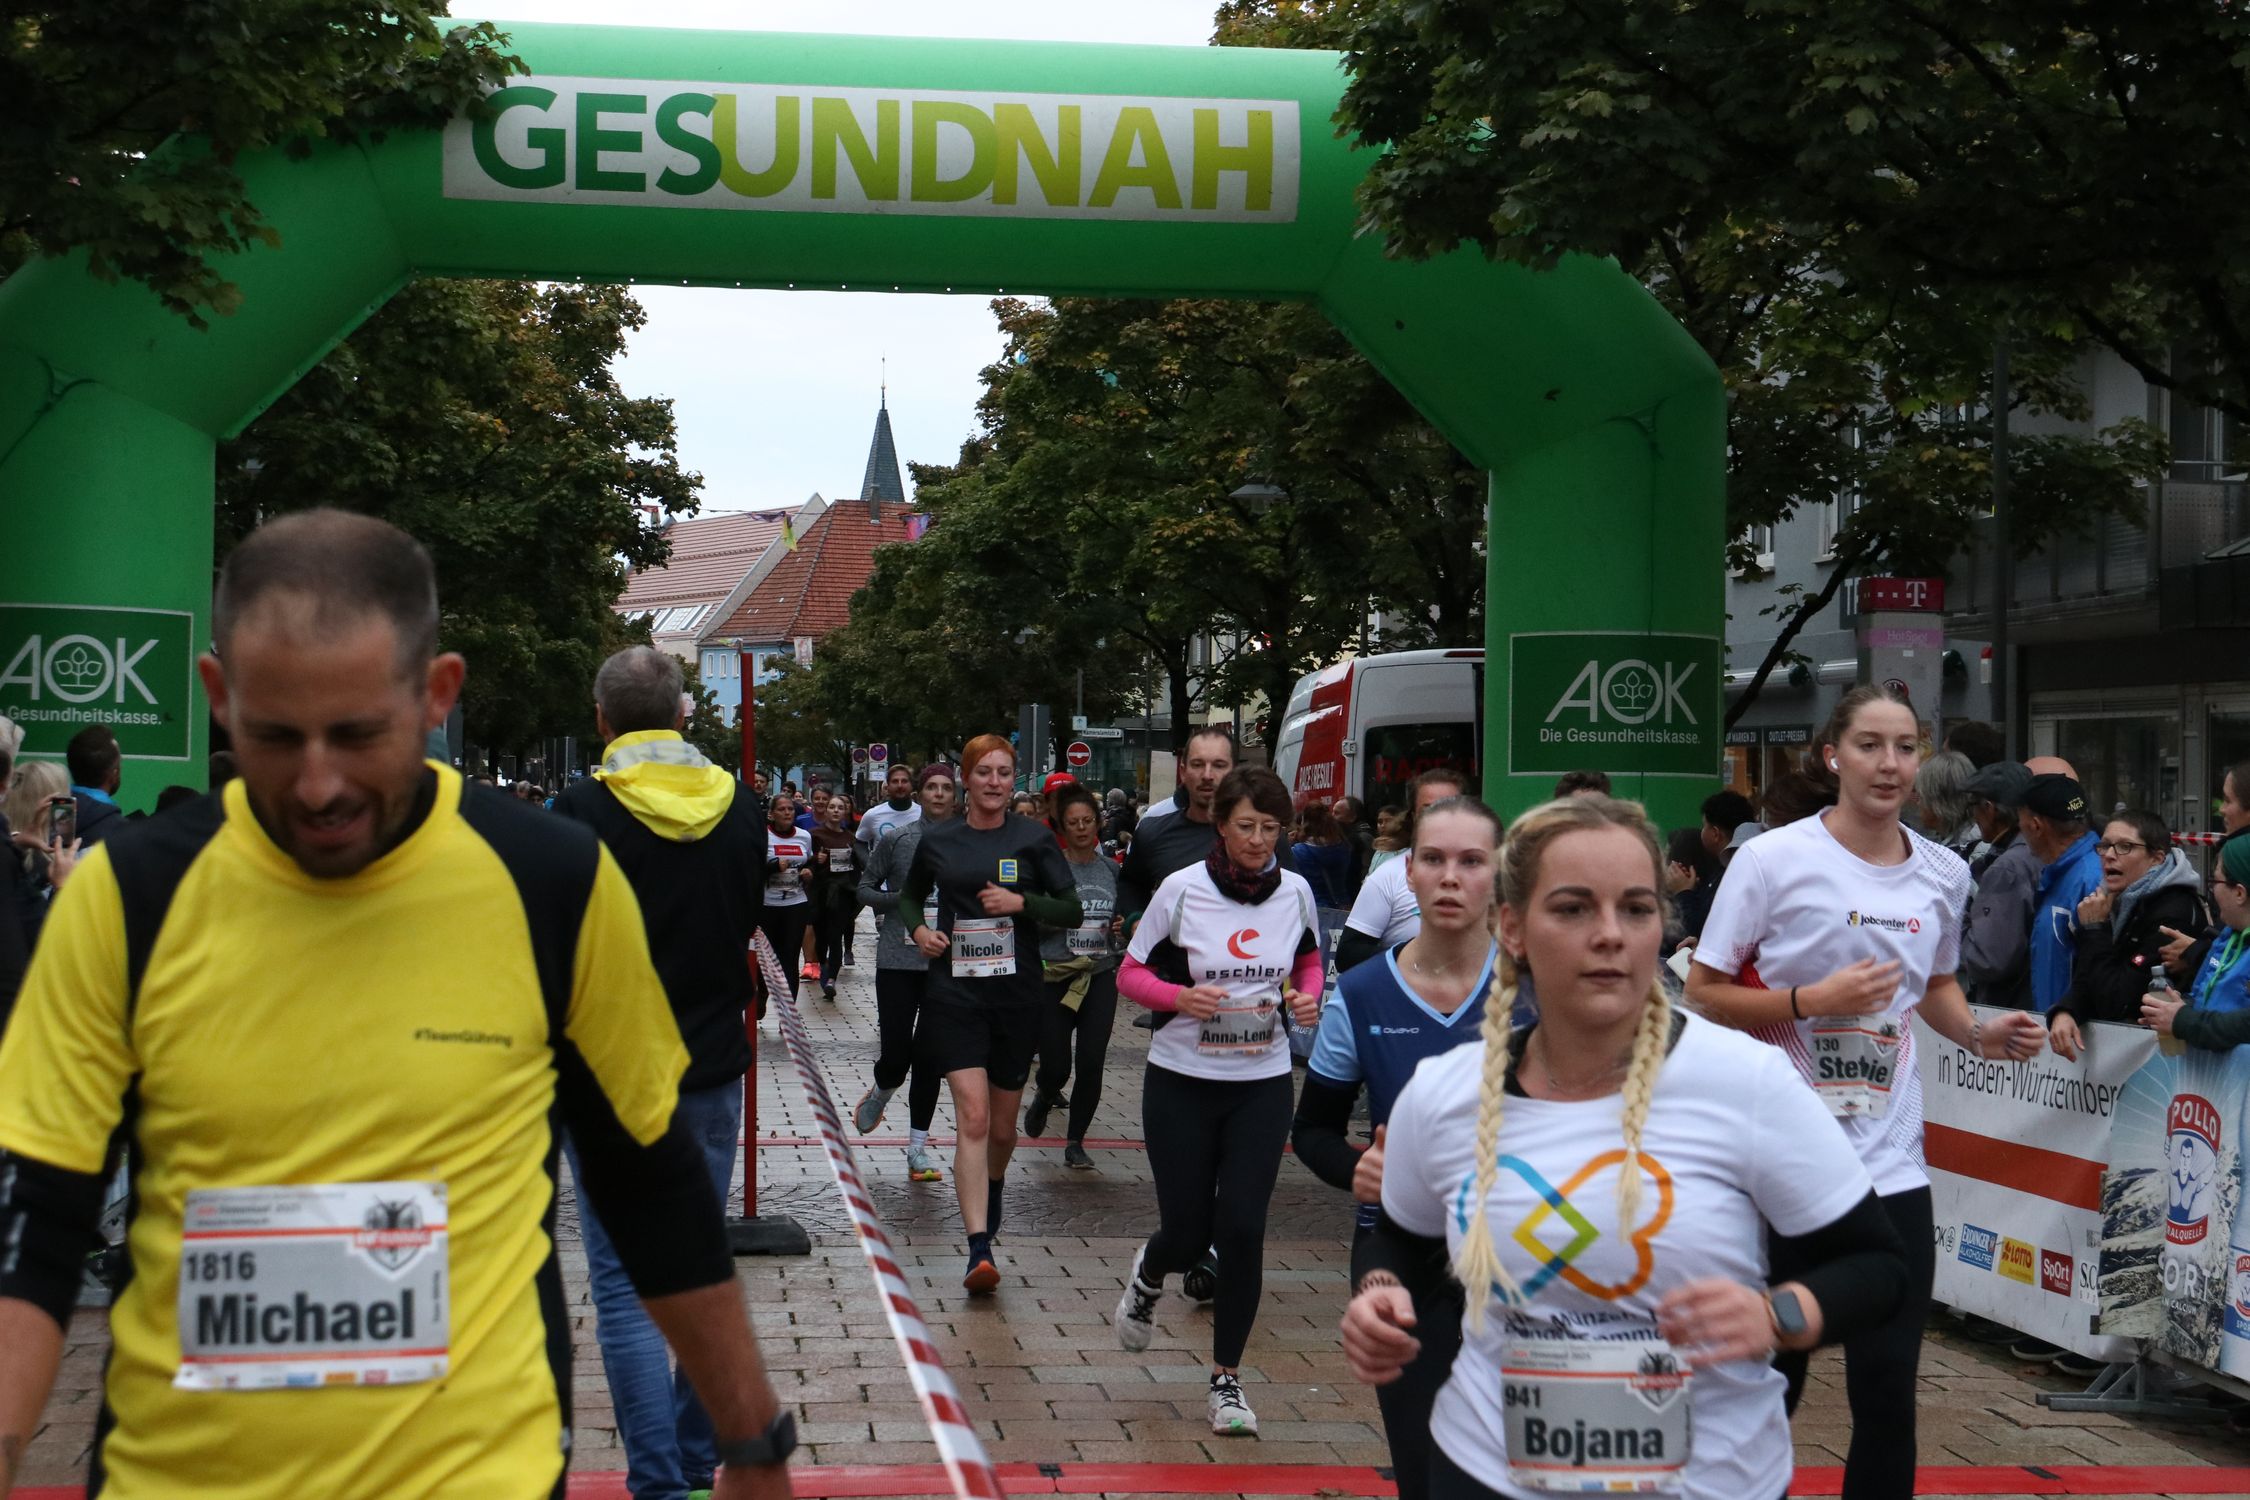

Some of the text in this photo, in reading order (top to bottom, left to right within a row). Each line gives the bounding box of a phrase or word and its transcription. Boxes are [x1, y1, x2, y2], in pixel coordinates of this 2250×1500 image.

[471, 84, 1274, 212] GESUNDNAH
[0, 634, 160, 704] AOK
[1544, 659, 1699, 725] AOK
[8, 705, 162, 725] Gesundheitskasse.
[1540, 728, 1701, 745] Die Gesundheitskasse.
[961, 943, 1004, 957] Nicole
[993, 967, 1008, 975] 619
[1205, 965, 1285, 980] eschler
[1814, 1038, 1840, 1052] 130
[1819, 1055, 1889, 1083] Stevie
[1938, 1044, 1951, 1085] in
[186, 1252, 256, 1282] 1816
[2010, 1245, 2033, 1269] LOTTO
[196, 1287, 415, 1346] Michael
[1505, 1385, 1542, 1409] 941
[1523, 1416, 1665, 1467] Bojana
